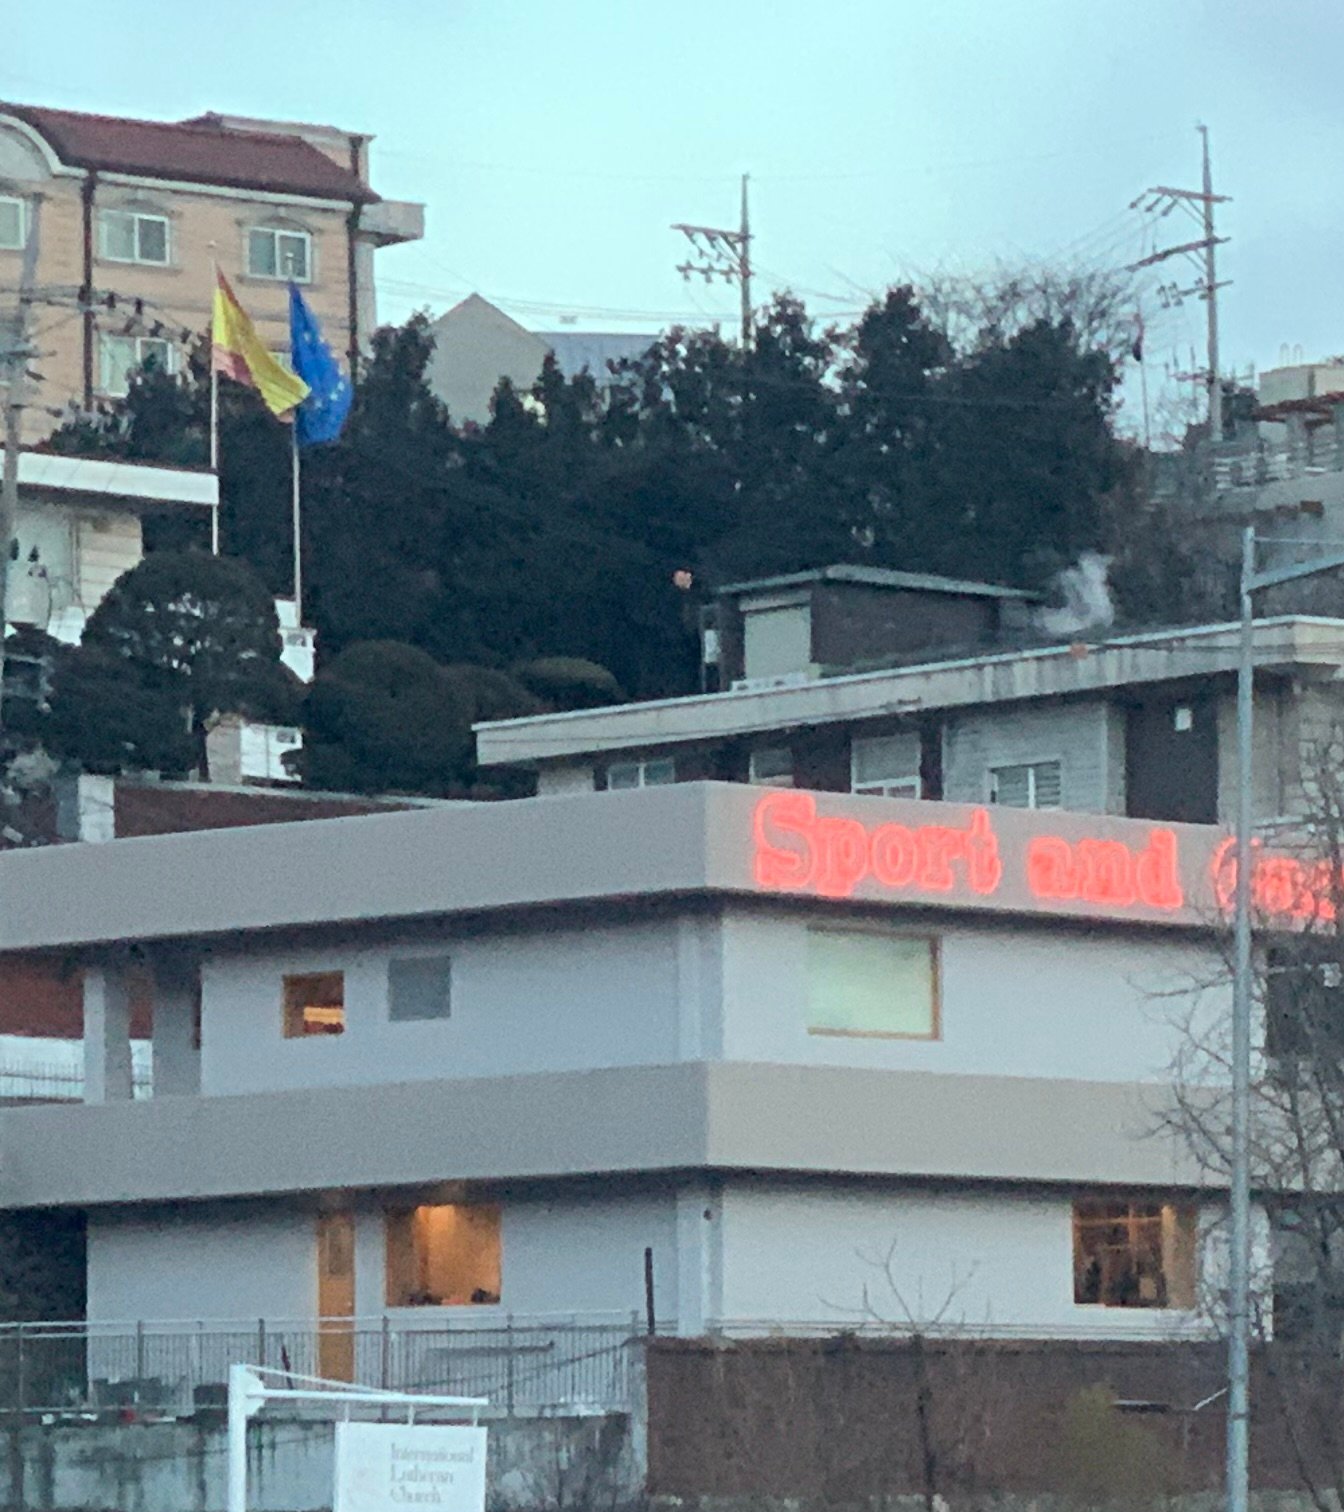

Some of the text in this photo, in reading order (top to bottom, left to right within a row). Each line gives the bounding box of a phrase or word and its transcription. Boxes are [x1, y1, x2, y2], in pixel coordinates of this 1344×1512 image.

[753, 790, 1002, 898] Sport
[1027, 827, 1184, 910] and
[390, 1442, 474, 1463] International
[390, 1463, 455, 1485] Lutheran
[390, 1485, 442, 1504] Church
